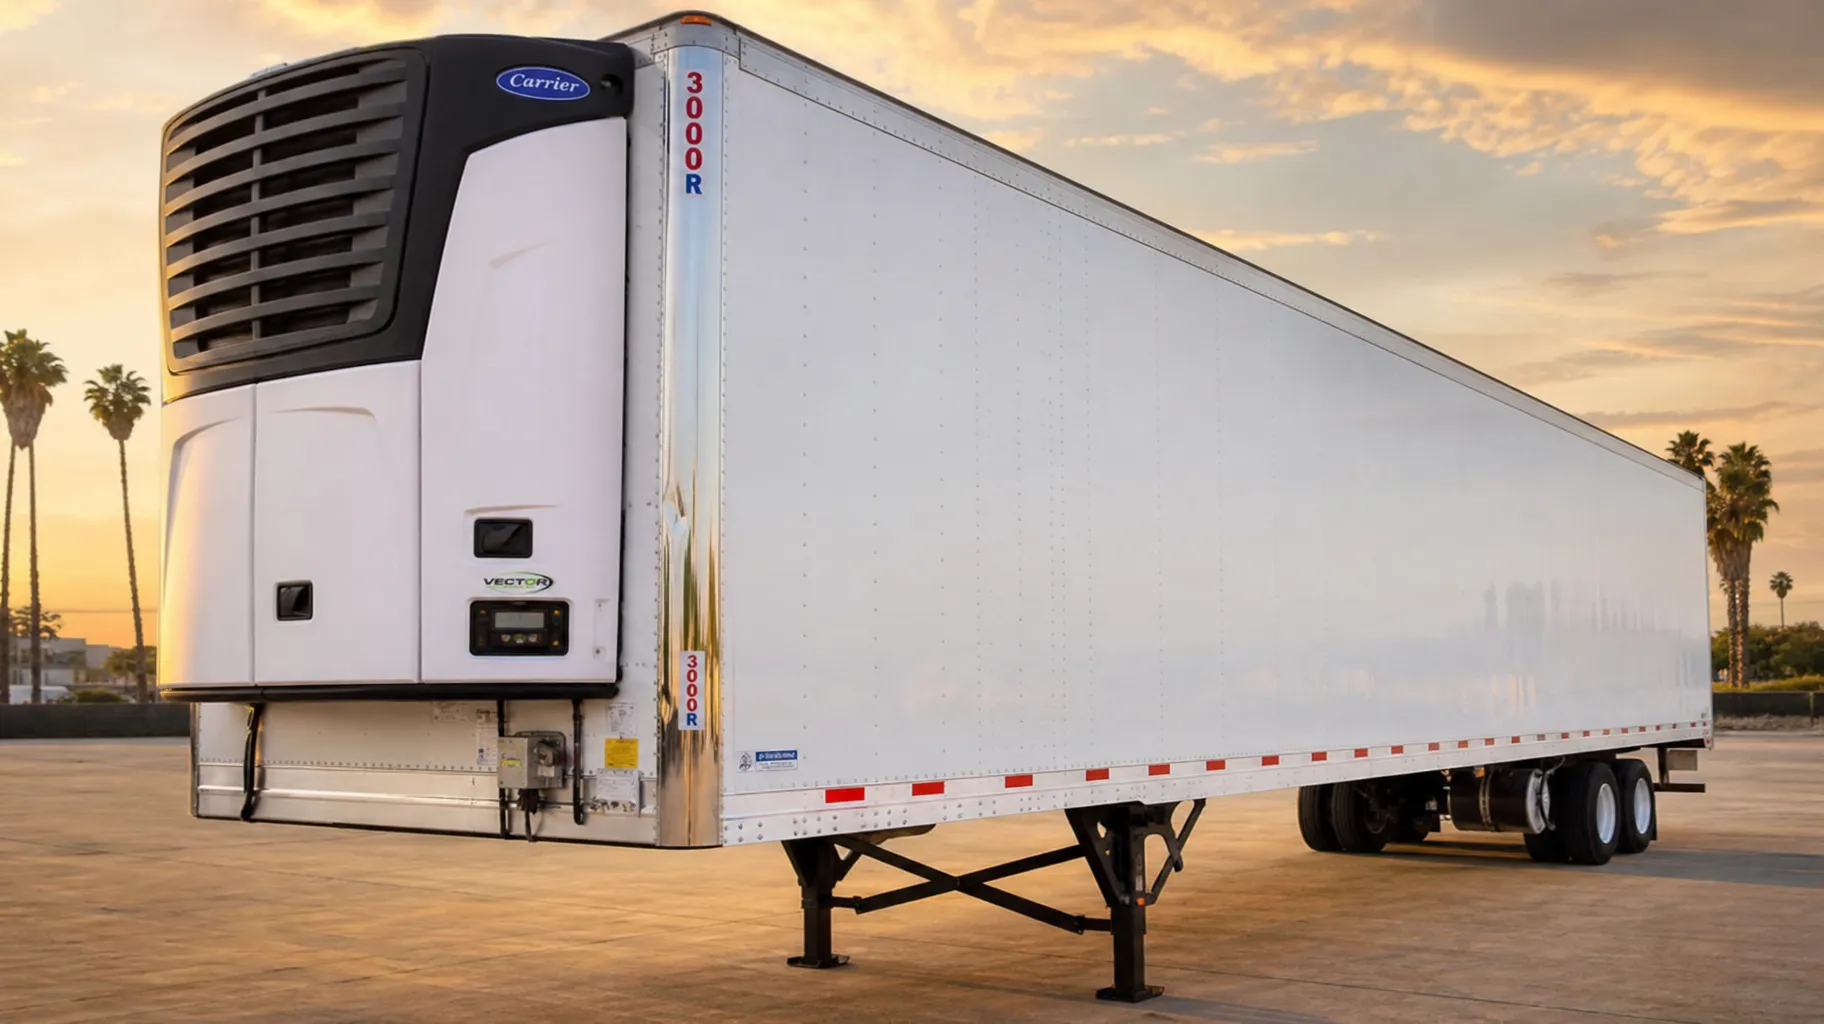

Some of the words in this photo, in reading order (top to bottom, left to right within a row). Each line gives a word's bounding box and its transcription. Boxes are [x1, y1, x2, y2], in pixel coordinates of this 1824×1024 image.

[509, 73, 580, 93] Carrier
[685, 71, 703, 195] 3000R
[483, 577, 548, 587] VECTOR
[686, 654, 698, 727] 3000R
